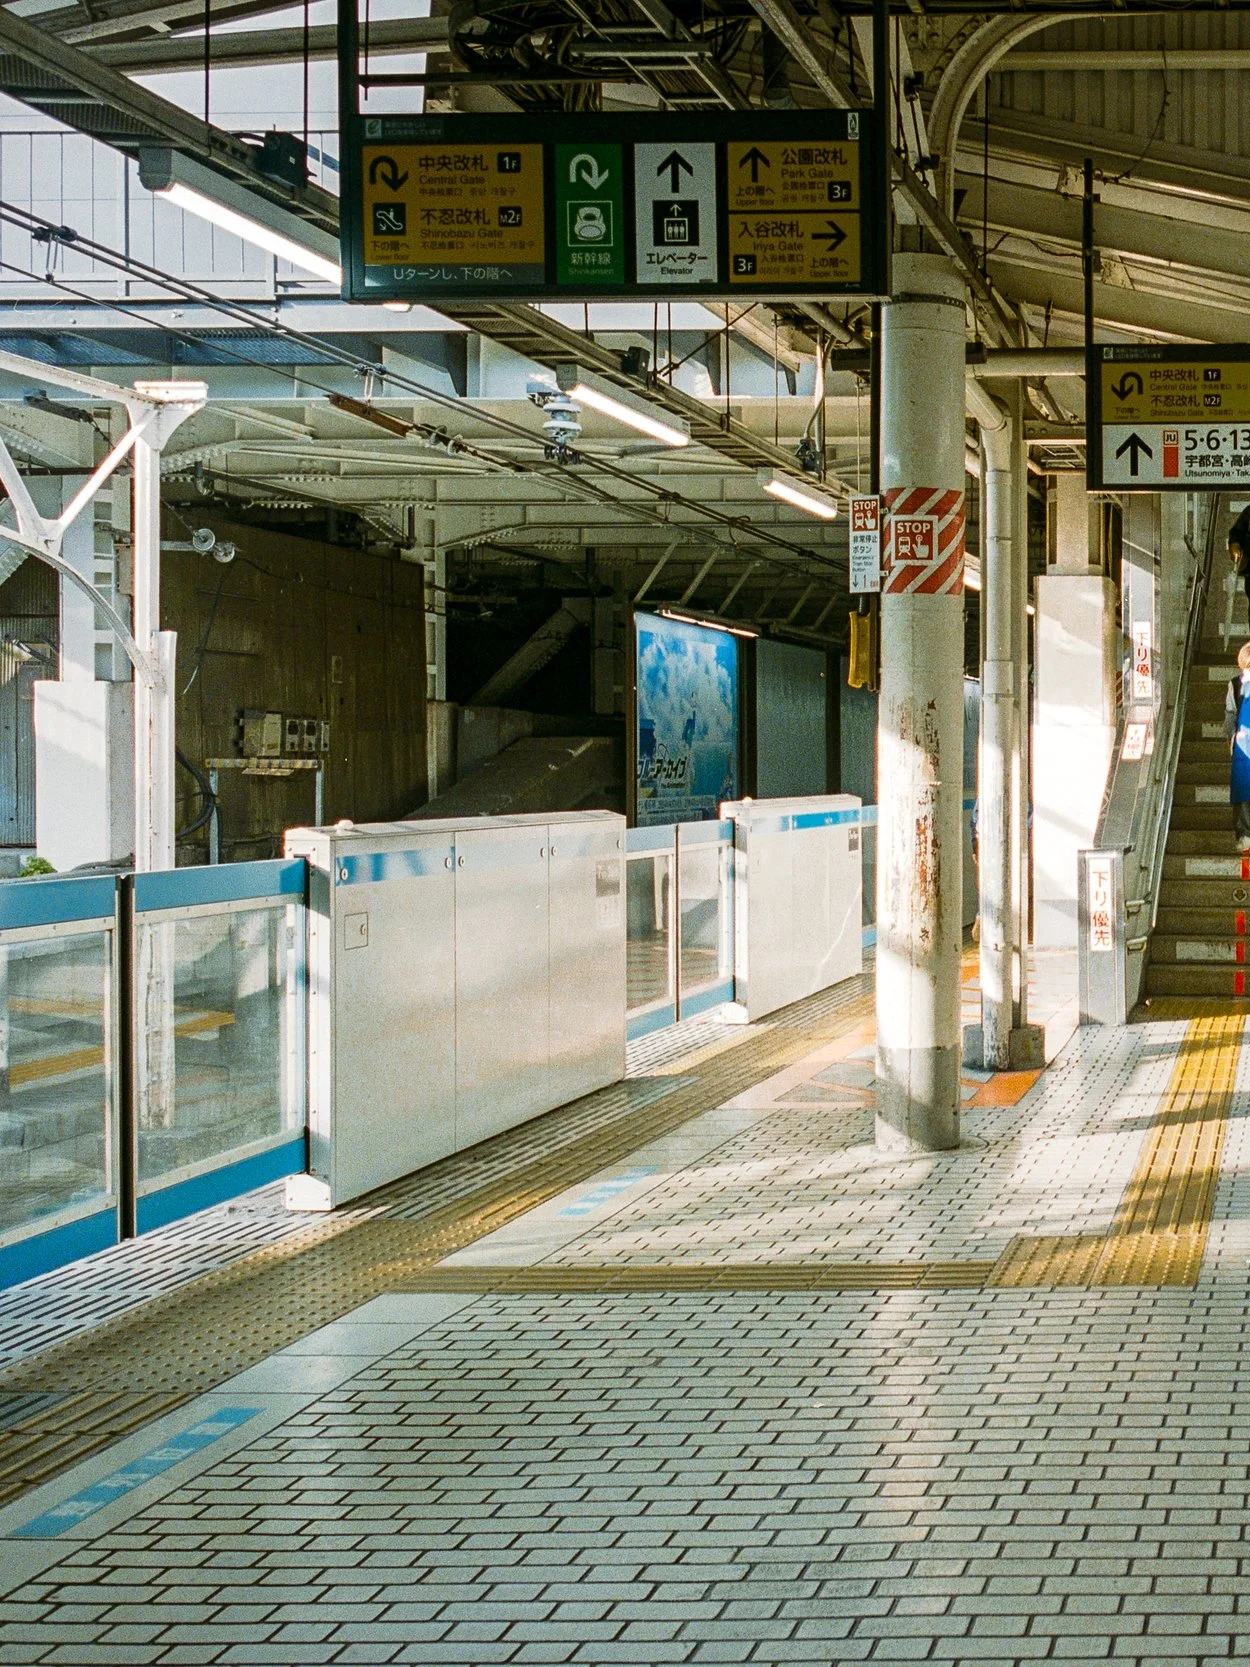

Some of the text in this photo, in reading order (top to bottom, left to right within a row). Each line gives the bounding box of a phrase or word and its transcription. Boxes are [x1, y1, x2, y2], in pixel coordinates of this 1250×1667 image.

[418, 154, 489, 173] 中央改札
[503, 156, 518, 170] 1F
[782, 148, 848, 166] 公園改札
[419, 174, 486, 185] Central Gate
[781, 168, 834, 178] Park Gate
[832, 184, 848, 199] 3F
[420, 208, 491, 226] 不忍改札
[500, 210, 521, 224] M2F
[420, 228, 504, 238] Shinobazu Gate
[738, 221, 804, 238] 入谷改札
[753, 241, 804, 252] Iriya Gate
[571, 252, 612, 266] 新幹線
[646, 252, 708, 265] エレベーター
[737, 258, 753, 272] 3F
[568, 267, 614, 276] Shinkansen
[660, 266, 694, 276] Elevator
[1150, 368, 1199, 382] 中央改札
[1207, 370, 1219, 380] 1F
[1150, 394, 1200, 408] 不忍改札
[1205, 396, 1221, 406] M2F
[1166, 434, 1176, 442] JU
[854, 500, 877, 510] STOP
[897, 522, 930, 534] STOP
[853, 534, 878, 544] 非常停止
[852, 546, 872, 554] ボタン
[1136, 631, 1151, 696] 下り優先
[1092, 870, 1111, 948] 下り優先
